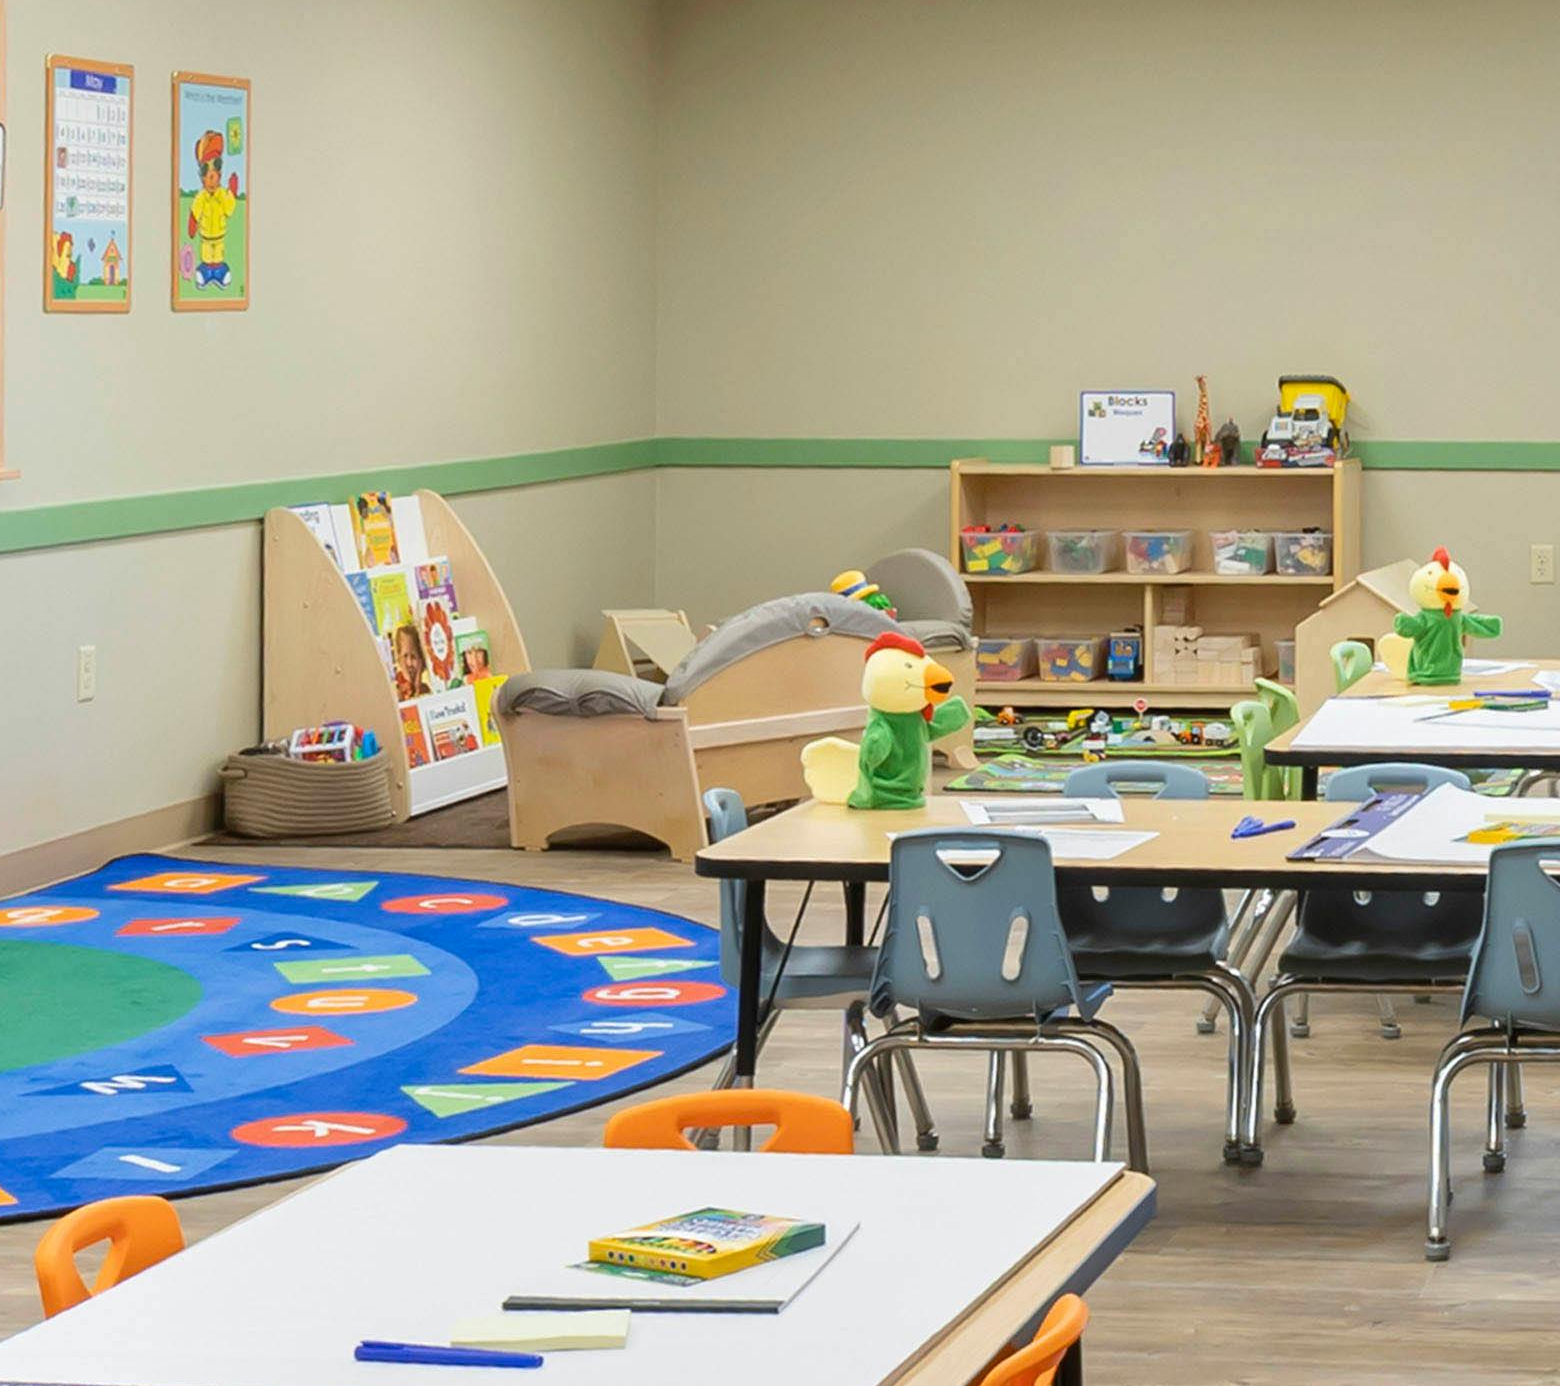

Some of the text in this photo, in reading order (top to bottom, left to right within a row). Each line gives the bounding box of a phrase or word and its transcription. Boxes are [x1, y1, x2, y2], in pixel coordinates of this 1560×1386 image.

[1108, 396, 1148, 407] Blocks
[163, 873, 213, 893] a
[419, 895, 473, 912] c
[577, 930, 633, 949] e
